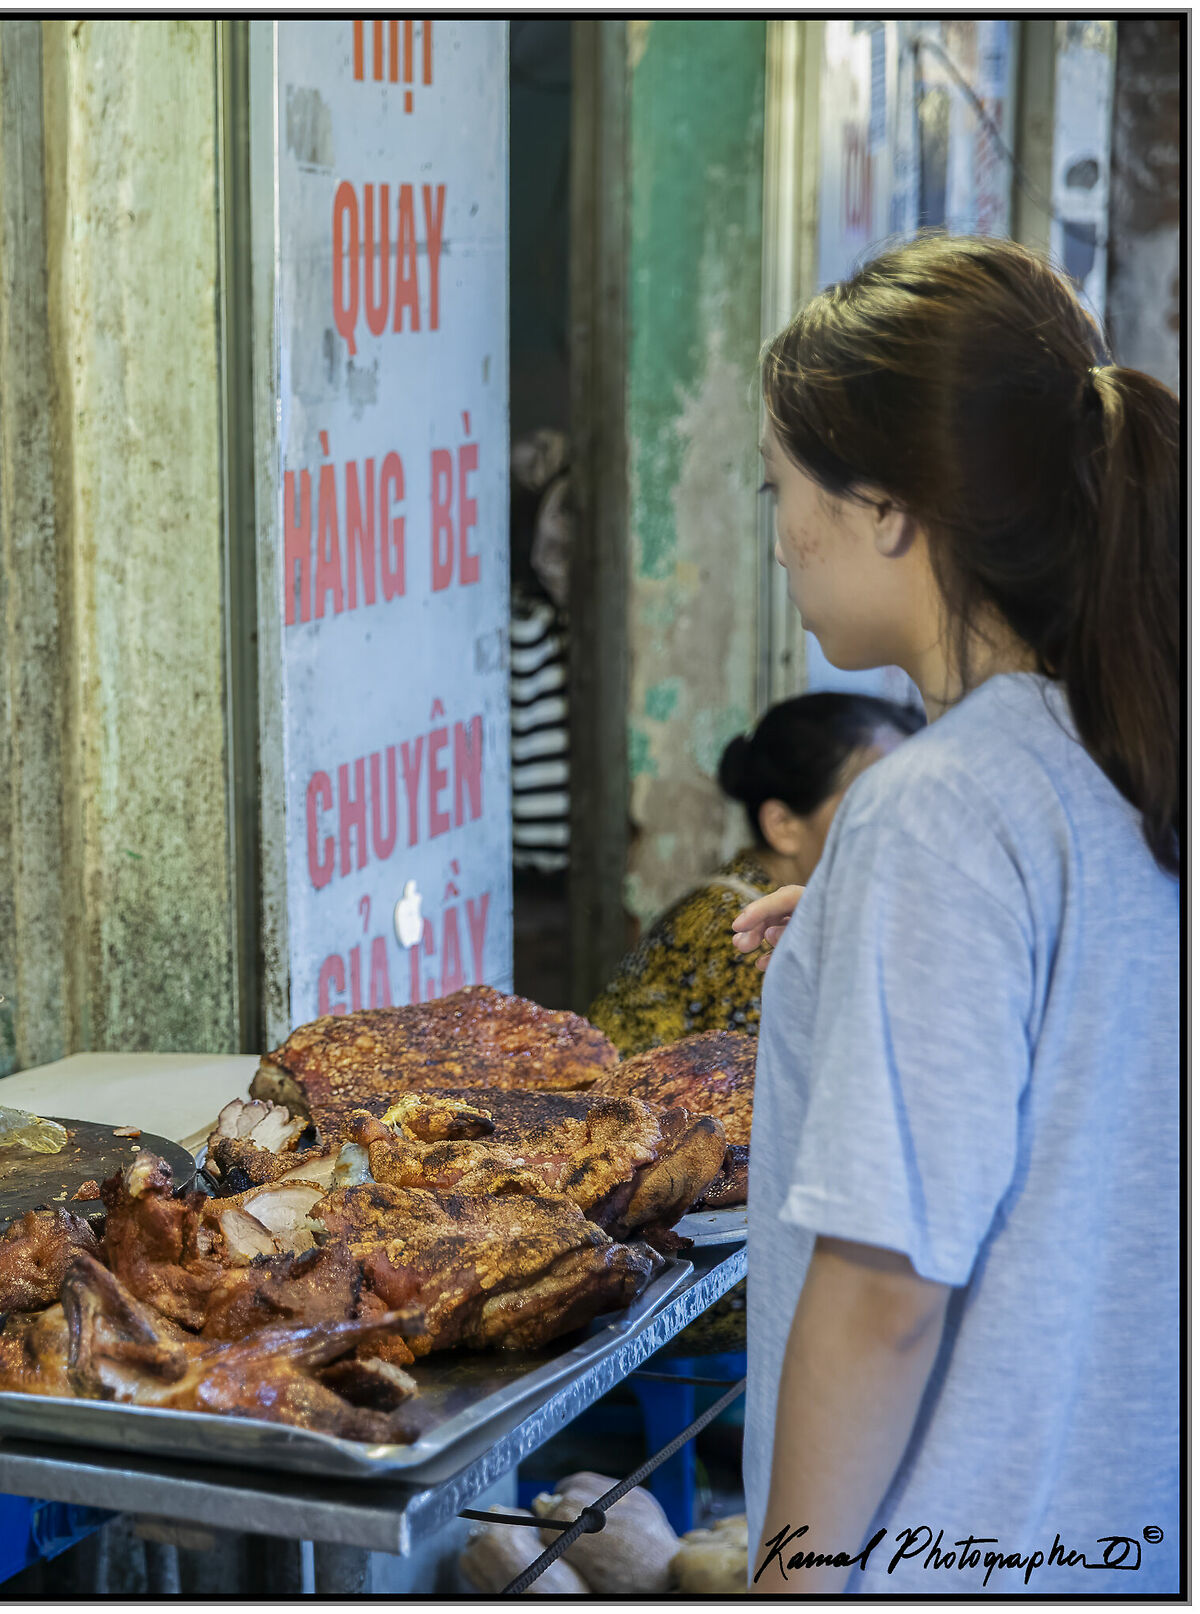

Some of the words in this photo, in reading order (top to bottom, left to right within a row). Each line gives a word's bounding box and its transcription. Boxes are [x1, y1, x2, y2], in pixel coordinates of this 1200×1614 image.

[332, 180, 447, 356] QUAY
[284, 429, 406, 627] HÀNG
[430, 410, 481, 592] BÈ
[306, 698, 483, 890] CHUYÊN
